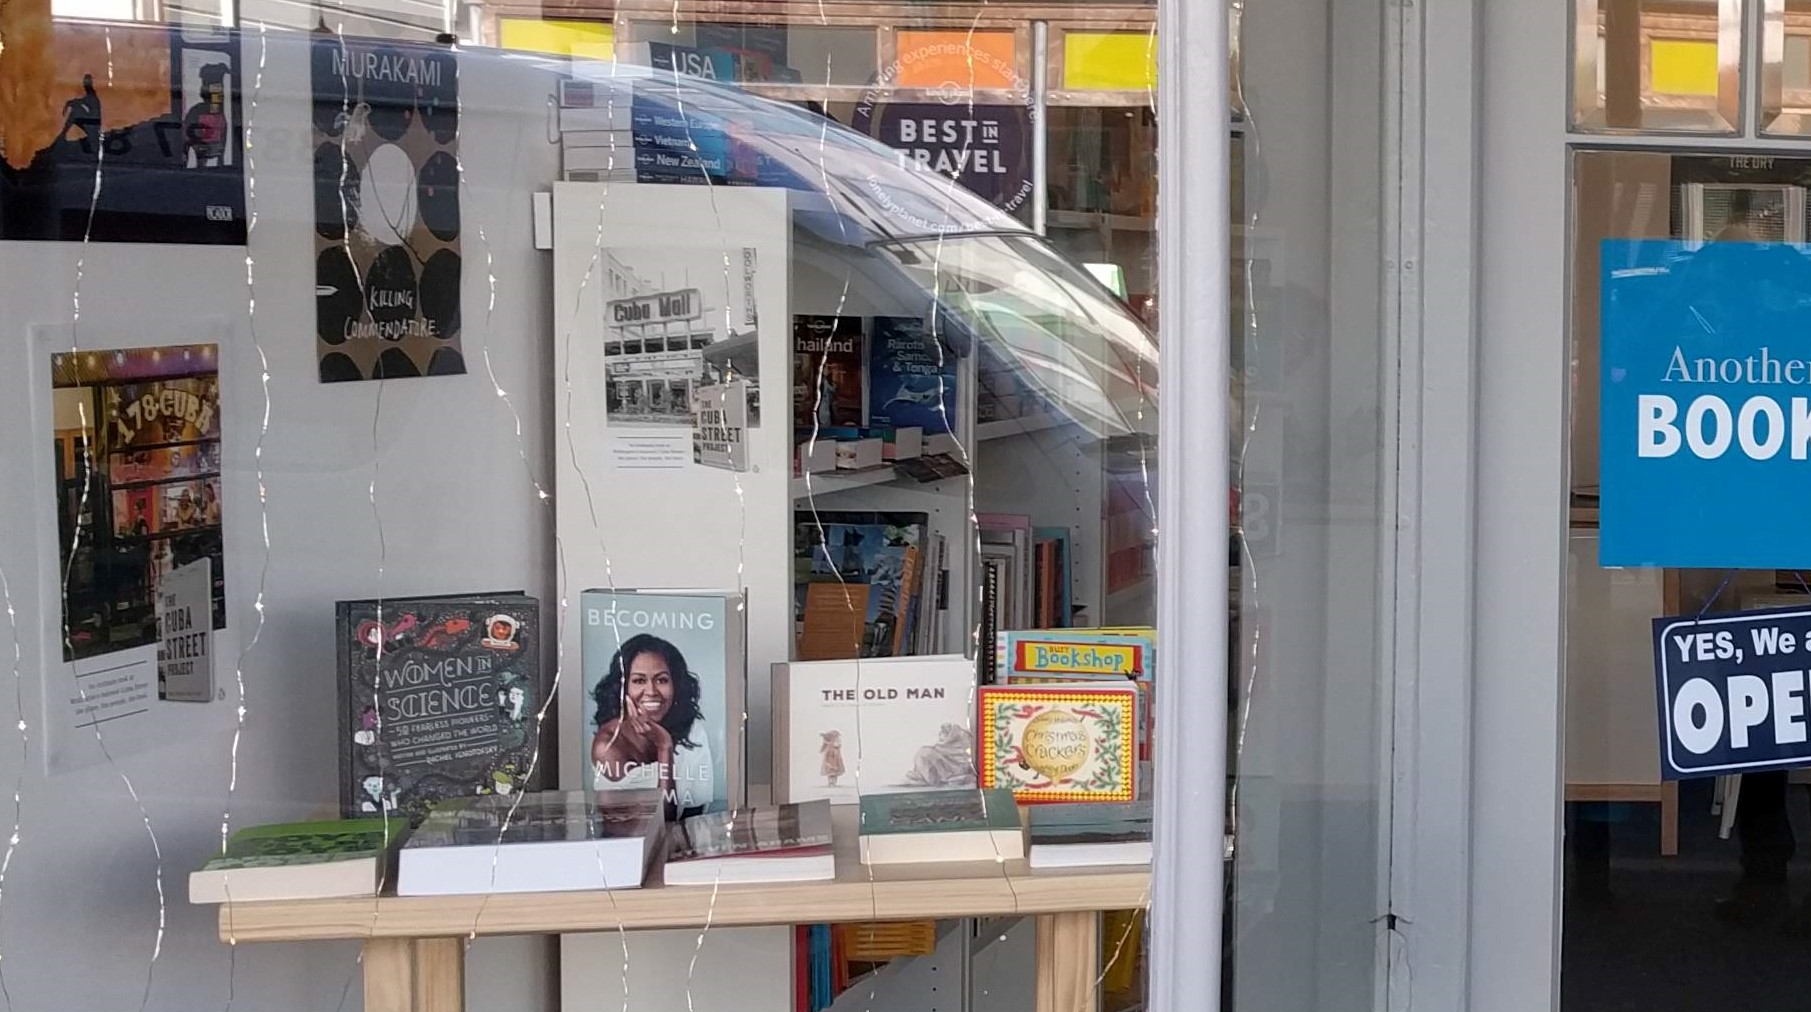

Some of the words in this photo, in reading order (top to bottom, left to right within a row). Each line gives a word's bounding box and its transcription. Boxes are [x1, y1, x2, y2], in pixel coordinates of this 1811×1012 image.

[675, 51, 716, 80] USA
[903, 42, 990, 64] experiences
[331, 48, 442, 86] MURAKAMI
[899, 118, 978, 144] BEST
[982, 125, 999, 140] IN
[655, 151, 680, 165] New
[892, 148, 1007, 174] TRAVEL
[368, 284, 415, 310] KILLING
[613, 301, 651, 323] Cuba
[658, 293, 691, 318] Mall
[797, 337, 854, 353] hailand
[117, 393, 160, 446] 178
[158, 387, 216, 435] CUBA
[701, 427, 742, 444] STREET
[587, 608, 715, 631] BECOMING
[165, 631, 207, 661] STREET
[1034, 645, 1124, 672] Bookshop
[1673, 631, 1744, 665] YES,
[1750, 626, 1797, 656] We
[383, 656, 473, 689] WOMEN
[386, 682, 495, 722] SCIENCE
[821, 689, 857, 702] THE
[863, 687, 899, 701] OLD
[906, 686, 945, 700] MAN
[595, 760, 711, 782] MICHELLE
